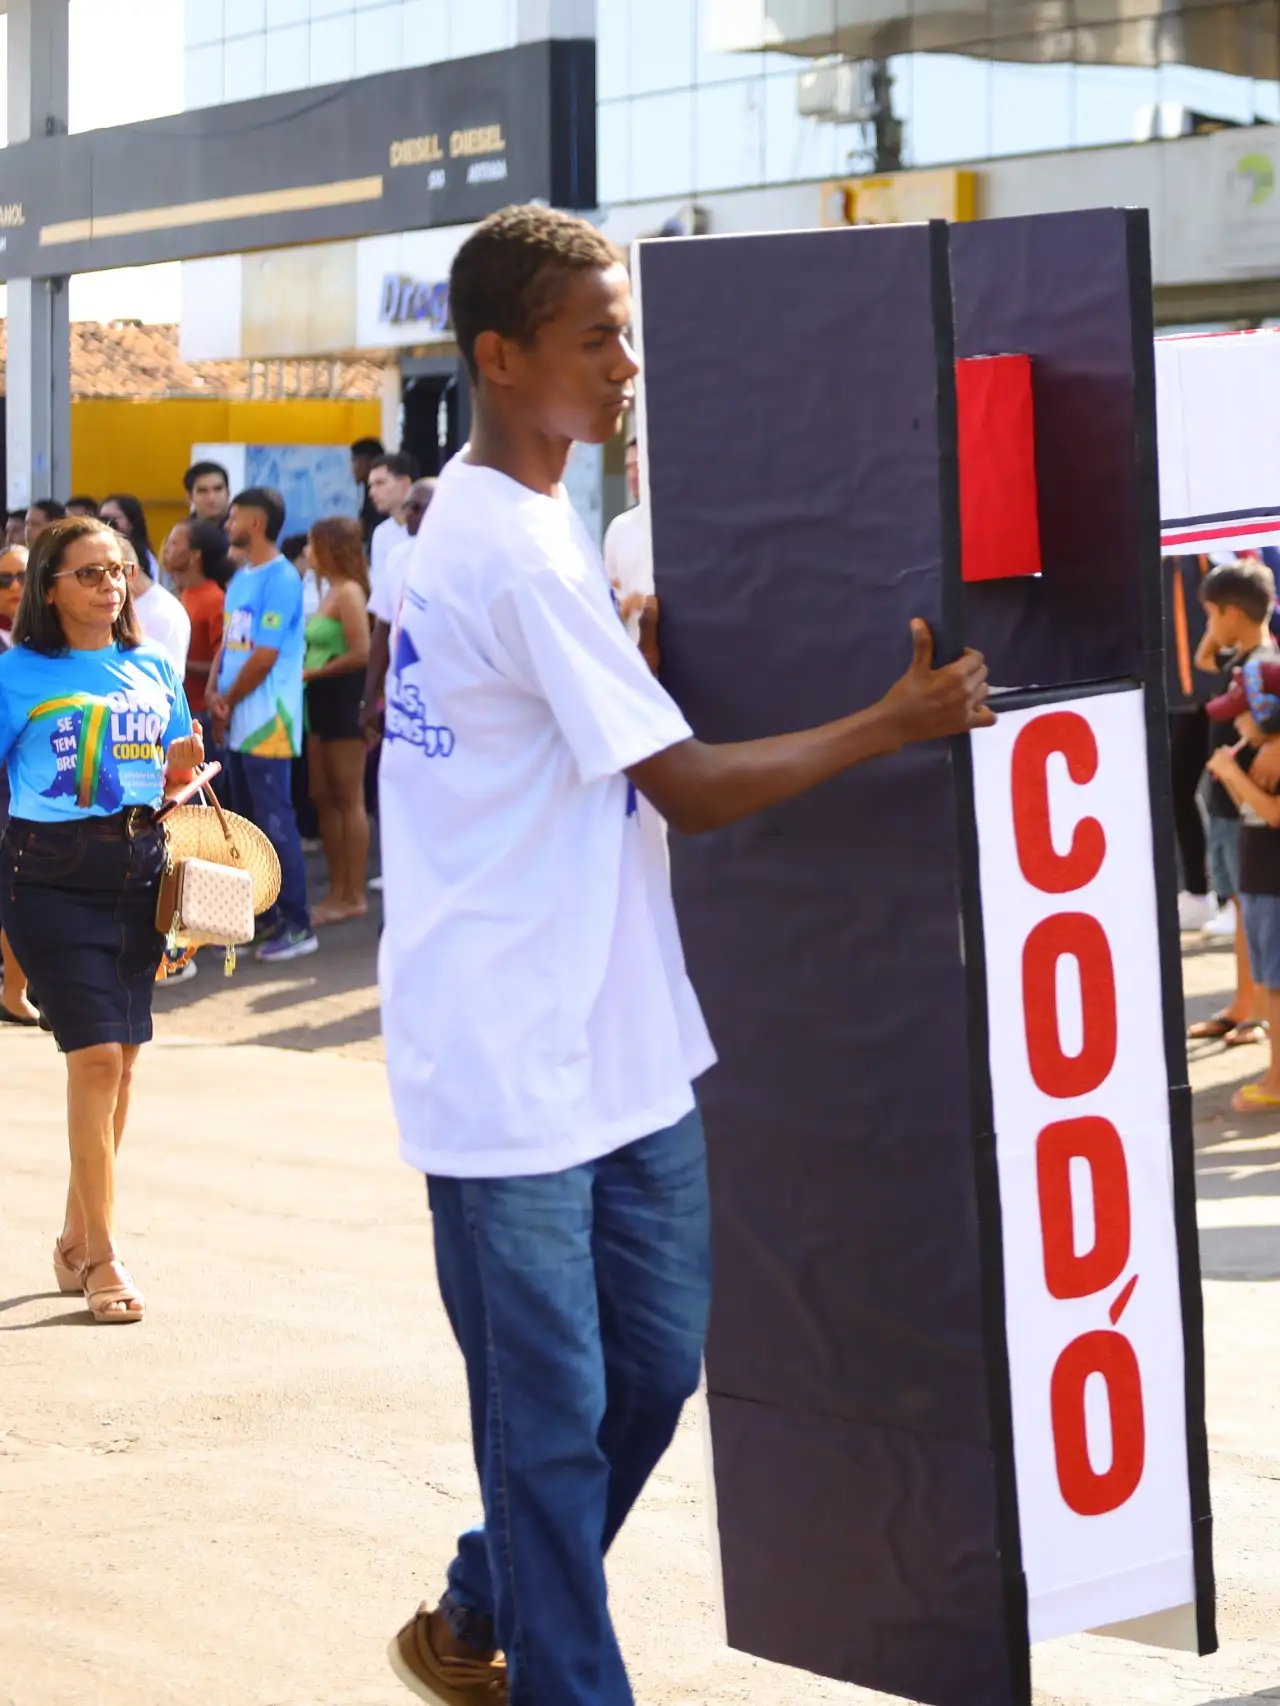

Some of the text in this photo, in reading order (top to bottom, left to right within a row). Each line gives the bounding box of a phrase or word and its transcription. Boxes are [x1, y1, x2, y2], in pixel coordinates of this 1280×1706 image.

[449, 124, 505, 157] DIESEL
[378, 273, 450, 332] Drog
[57, 716, 73, 733] SE
[53, 735, 76, 754] TEM
[1011, 711, 1145, 1516] CODÓ
